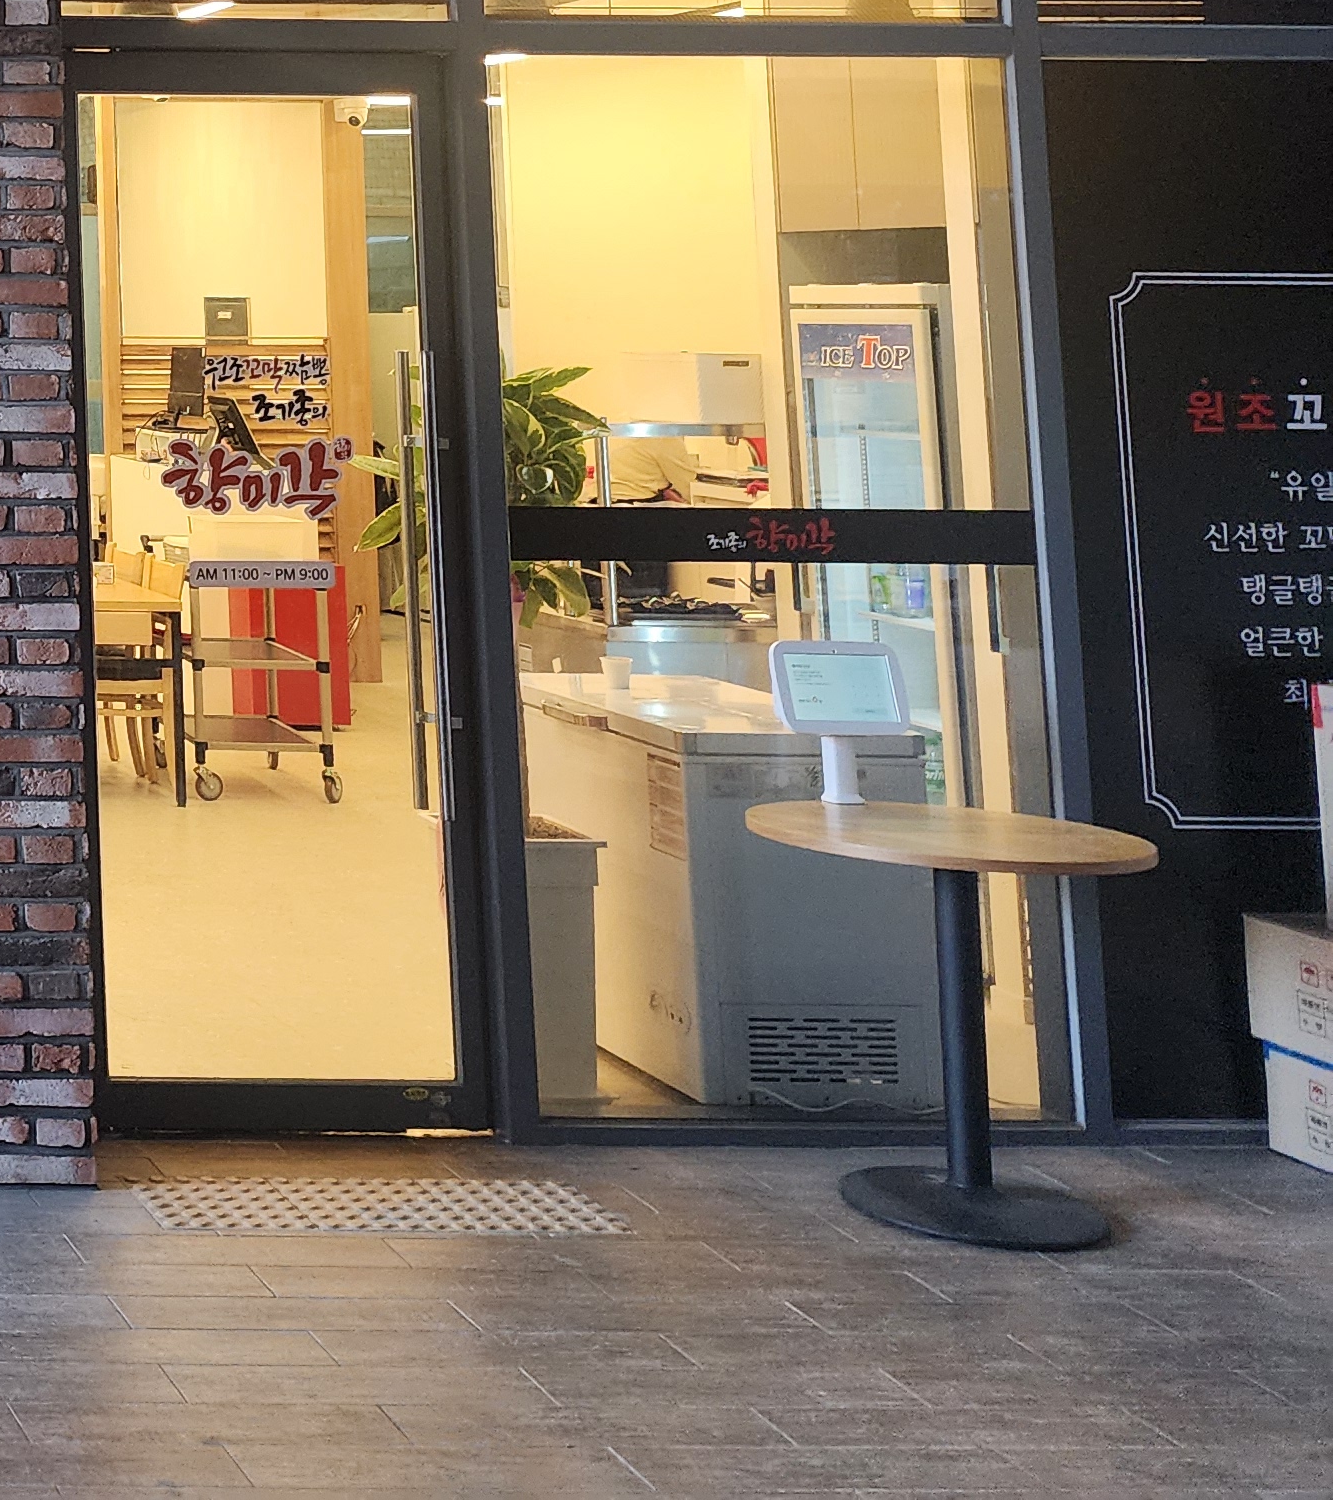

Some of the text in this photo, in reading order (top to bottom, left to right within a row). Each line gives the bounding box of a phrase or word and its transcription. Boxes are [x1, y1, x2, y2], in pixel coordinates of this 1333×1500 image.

[821, 334, 911, 370] ICE TOP
[202, 354, 331, 392] 원조꼬막짬뽕
[252, 389, 328, 426] 조기종의
[162, 438, 340, 517] 향미각
[746, 516, 836, 555] 향미각
[1204, 521, 1333, 553] 신선한 꼬
[195, 567, 218, 581] AM
[222, 567, 259, 581] 11:00
[274, 567, 296, 581] PM
[299, 567, 329, 581] 9:00
[1240, 573, 1333, 606] 탱글탱
[1240, 626, 1324, 657] 얼큰한
